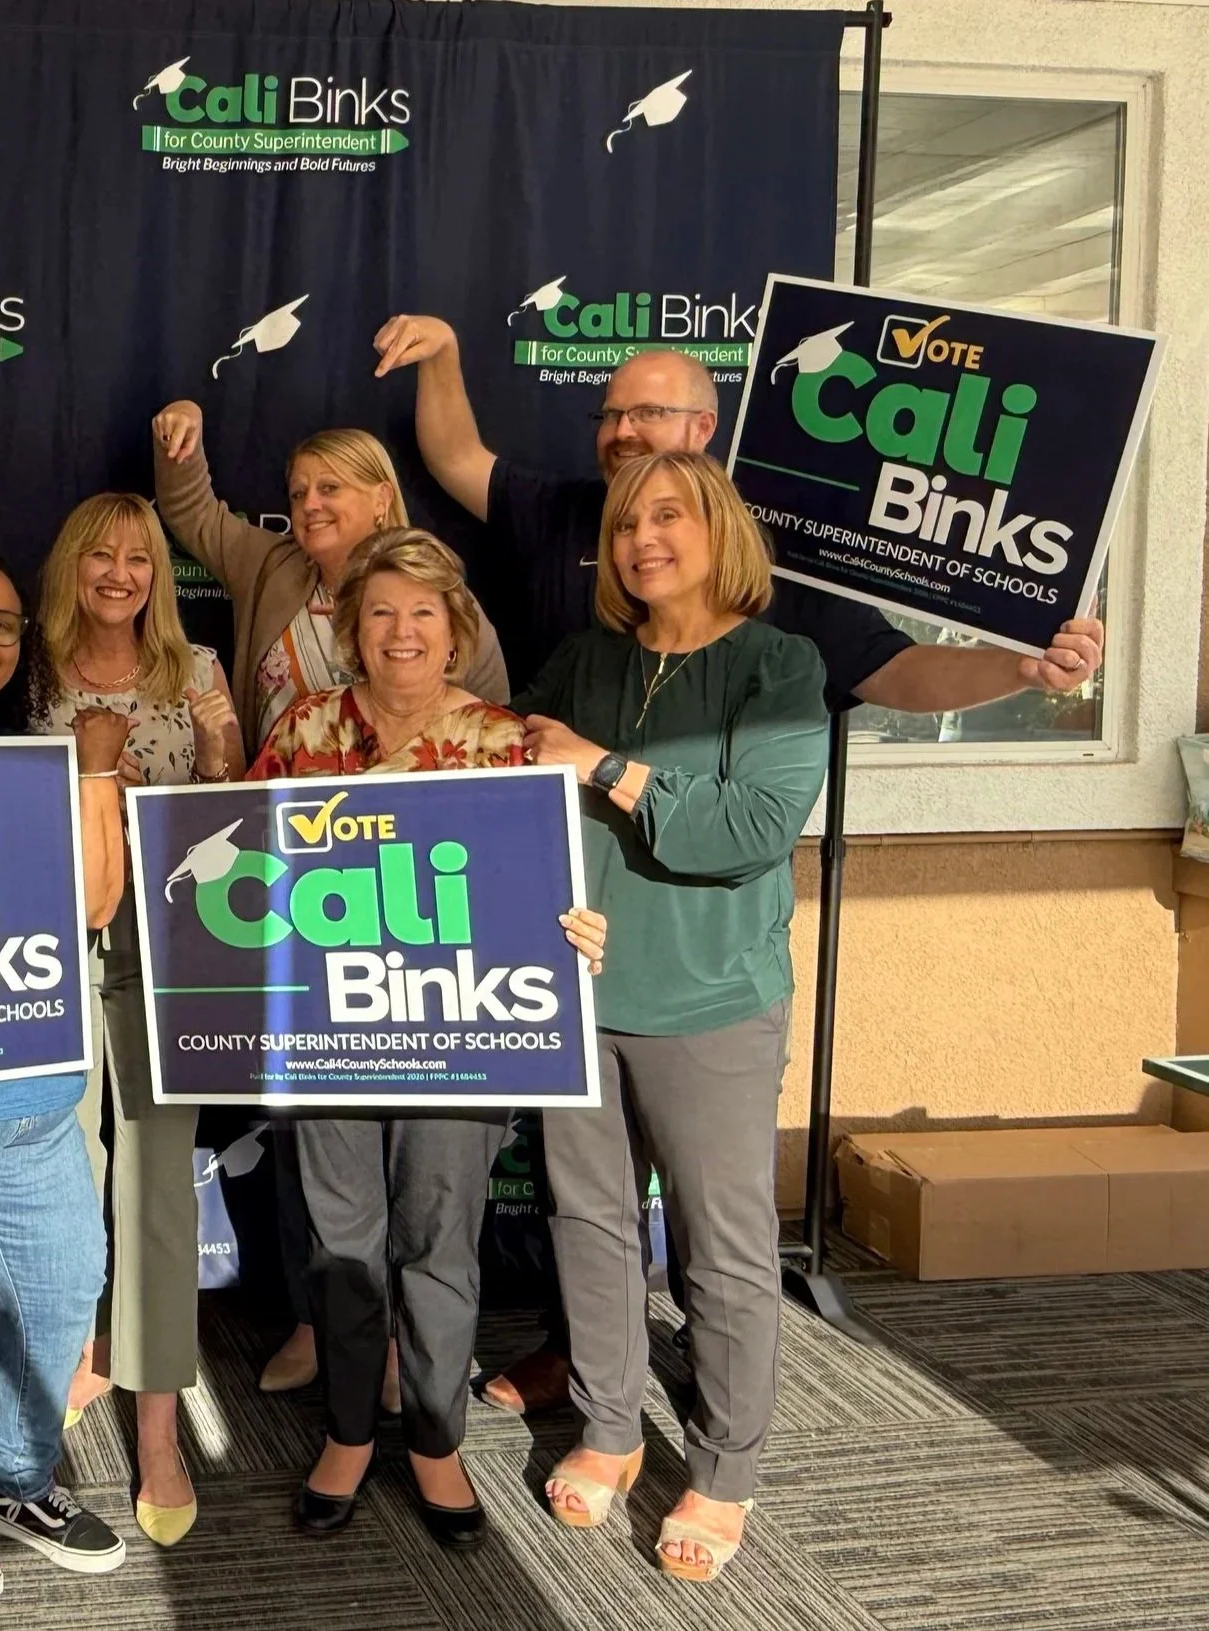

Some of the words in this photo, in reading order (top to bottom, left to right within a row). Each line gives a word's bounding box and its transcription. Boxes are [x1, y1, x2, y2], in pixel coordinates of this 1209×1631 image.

[166, 74, 279, 124] Cali
[290, 76, 410, 125] Binks
[164, 131, 187, 148] for
[191, 131, 249, 152] County
[254, 132, 376, 153] Superintendent
[162, 157, 200, 172] Bright
[203, 158, 272, 173] Beginnings
[274, 158, 298, 171] and
[300, 158, 329, 171] Bold
[331, 159, 376, 172] Futures
[543, 292, 651, 338] Cali
[661, 292, 759, 338] Bink
[541, 346, 563, 361] for
[566, 346, 621, 365] County
[540, 370, 575, 384] Bright
[791, 350, 1037, 485] Cali
[868, 461, 1073, 575] Binks
[803, 520, 946, 572] SUPERINTENDENT
[947, 560, 972, 579] OF
[974, 568, 1059, 604] SCHOOLS
[195, 841, 472, 948] Cali
[325, 949, 559, 1023] Binks
[178, 1034, 258, 1051] COUNTY
[260, 1032, 432, 1051] SUPERINTENDENT
[433, 1032, 460, 1050] OF
[465, 1031, 561, 1050] SCHOOLS
[497, 1181, 520, 1196] for
[495, 1202, 532, 1215] Bright
